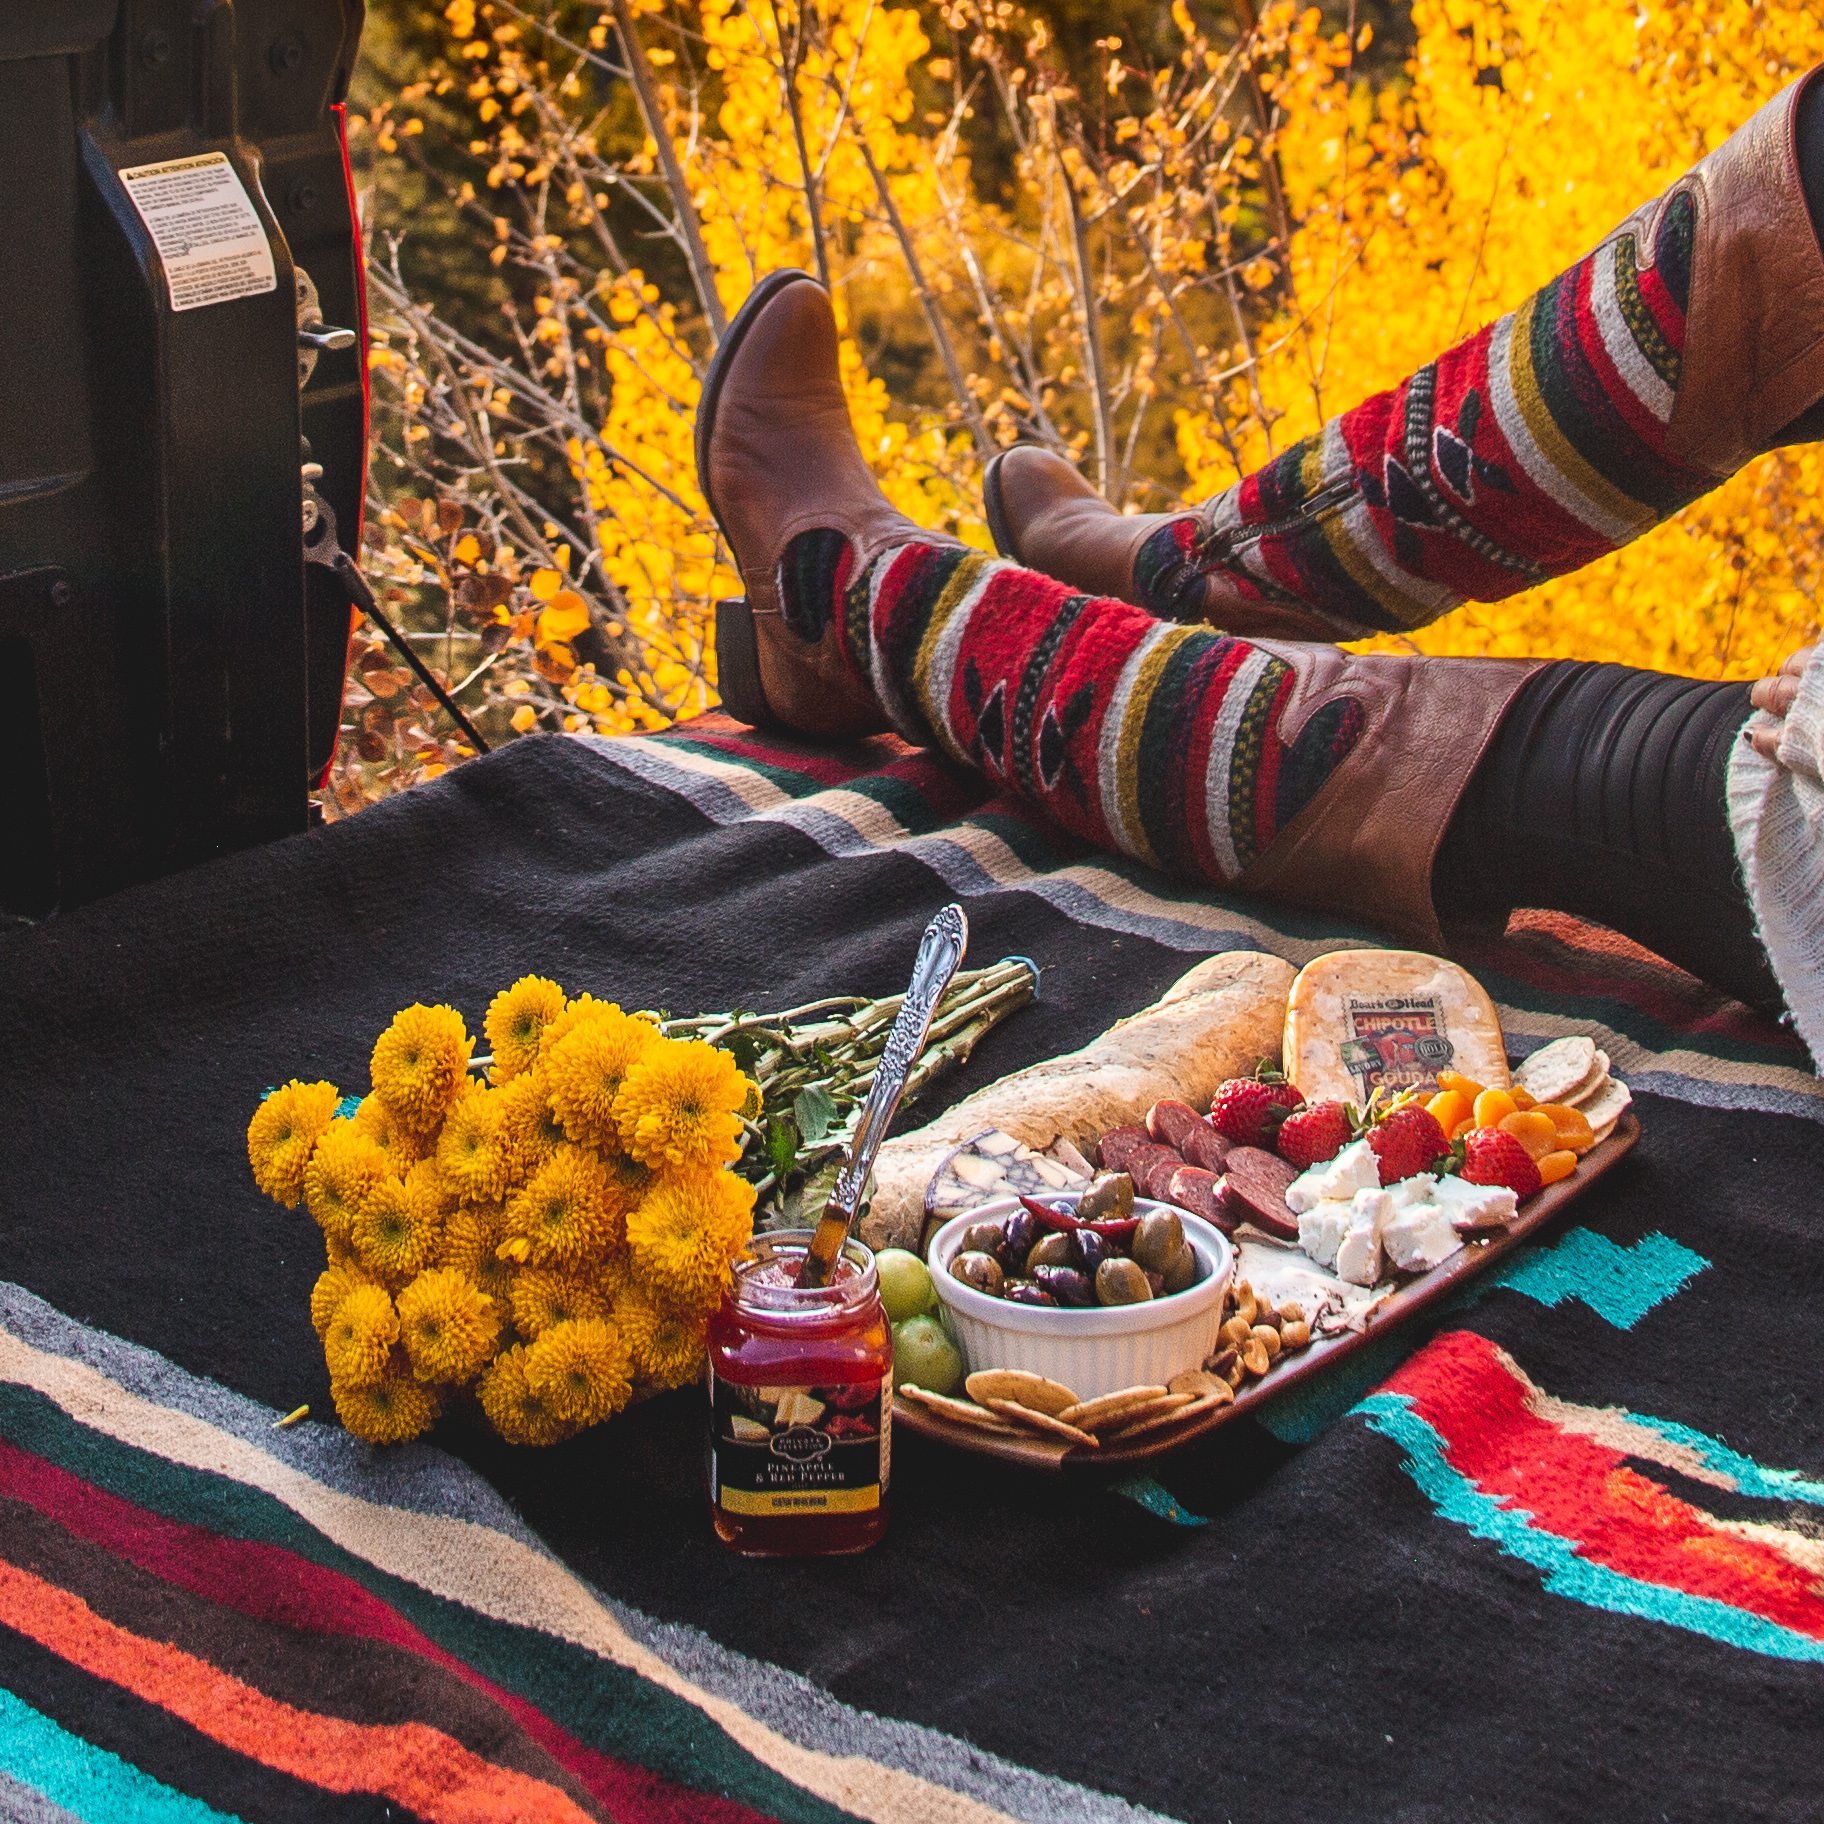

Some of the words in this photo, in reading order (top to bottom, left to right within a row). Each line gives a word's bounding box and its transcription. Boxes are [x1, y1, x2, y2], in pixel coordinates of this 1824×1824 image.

[133, 169, 160, 179] CAUTION
[162, 163, 194, 173] ATTENTION
[1350, 998, 1384, 1010] Boar's
[1404, 997, 1434, 1009] Head
[1354, 1016, 1436, 1031] CHIPOTLE
[1419, 1041, 1448, 1054] BOLD
[1348, 1059, 1382, 1073] SAVORY
[1370, 1070, 1437, 1085] GOUDA
[767, 1462, 834, 1472] PINEAPPLE
